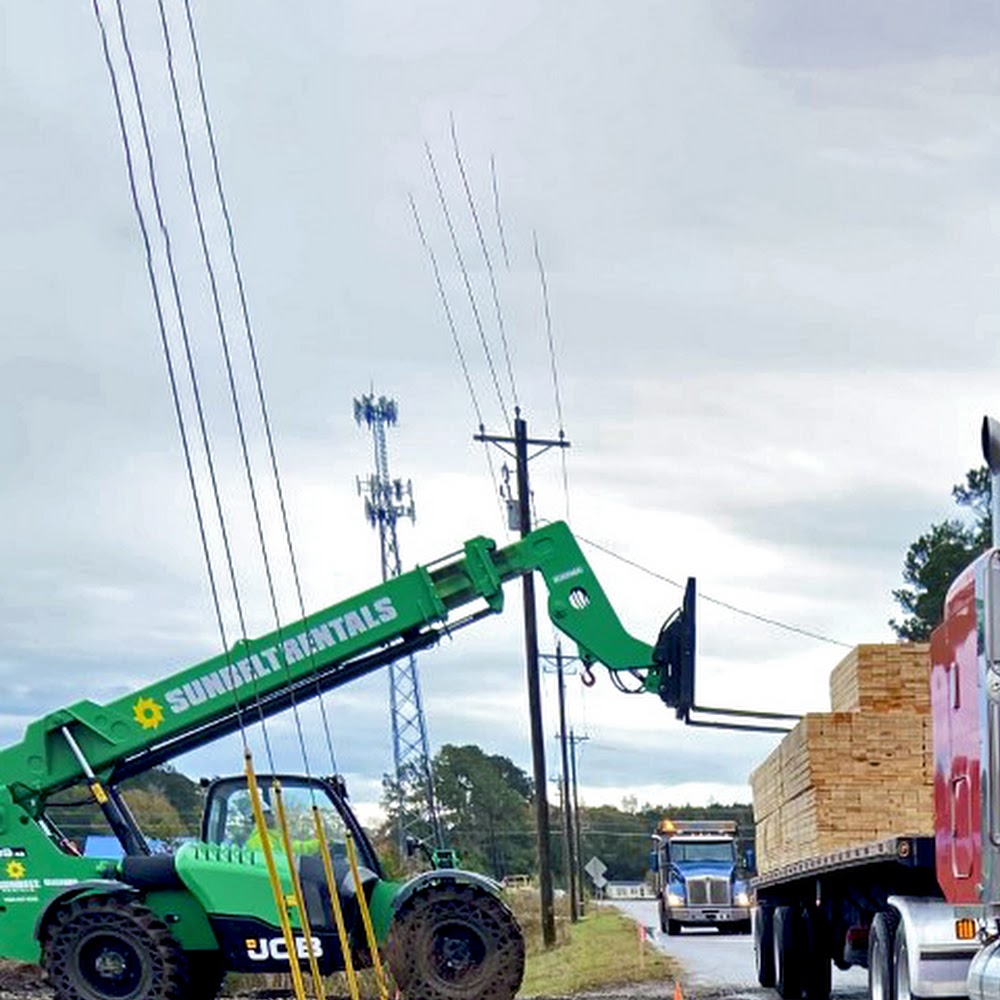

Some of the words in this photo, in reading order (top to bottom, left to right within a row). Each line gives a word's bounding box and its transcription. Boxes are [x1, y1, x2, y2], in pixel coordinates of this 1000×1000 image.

[164, 646, 282, 714] SUNBELT
[281, 597, 398, 666] RENTALS
[246, 937, 323, 960] JCB
